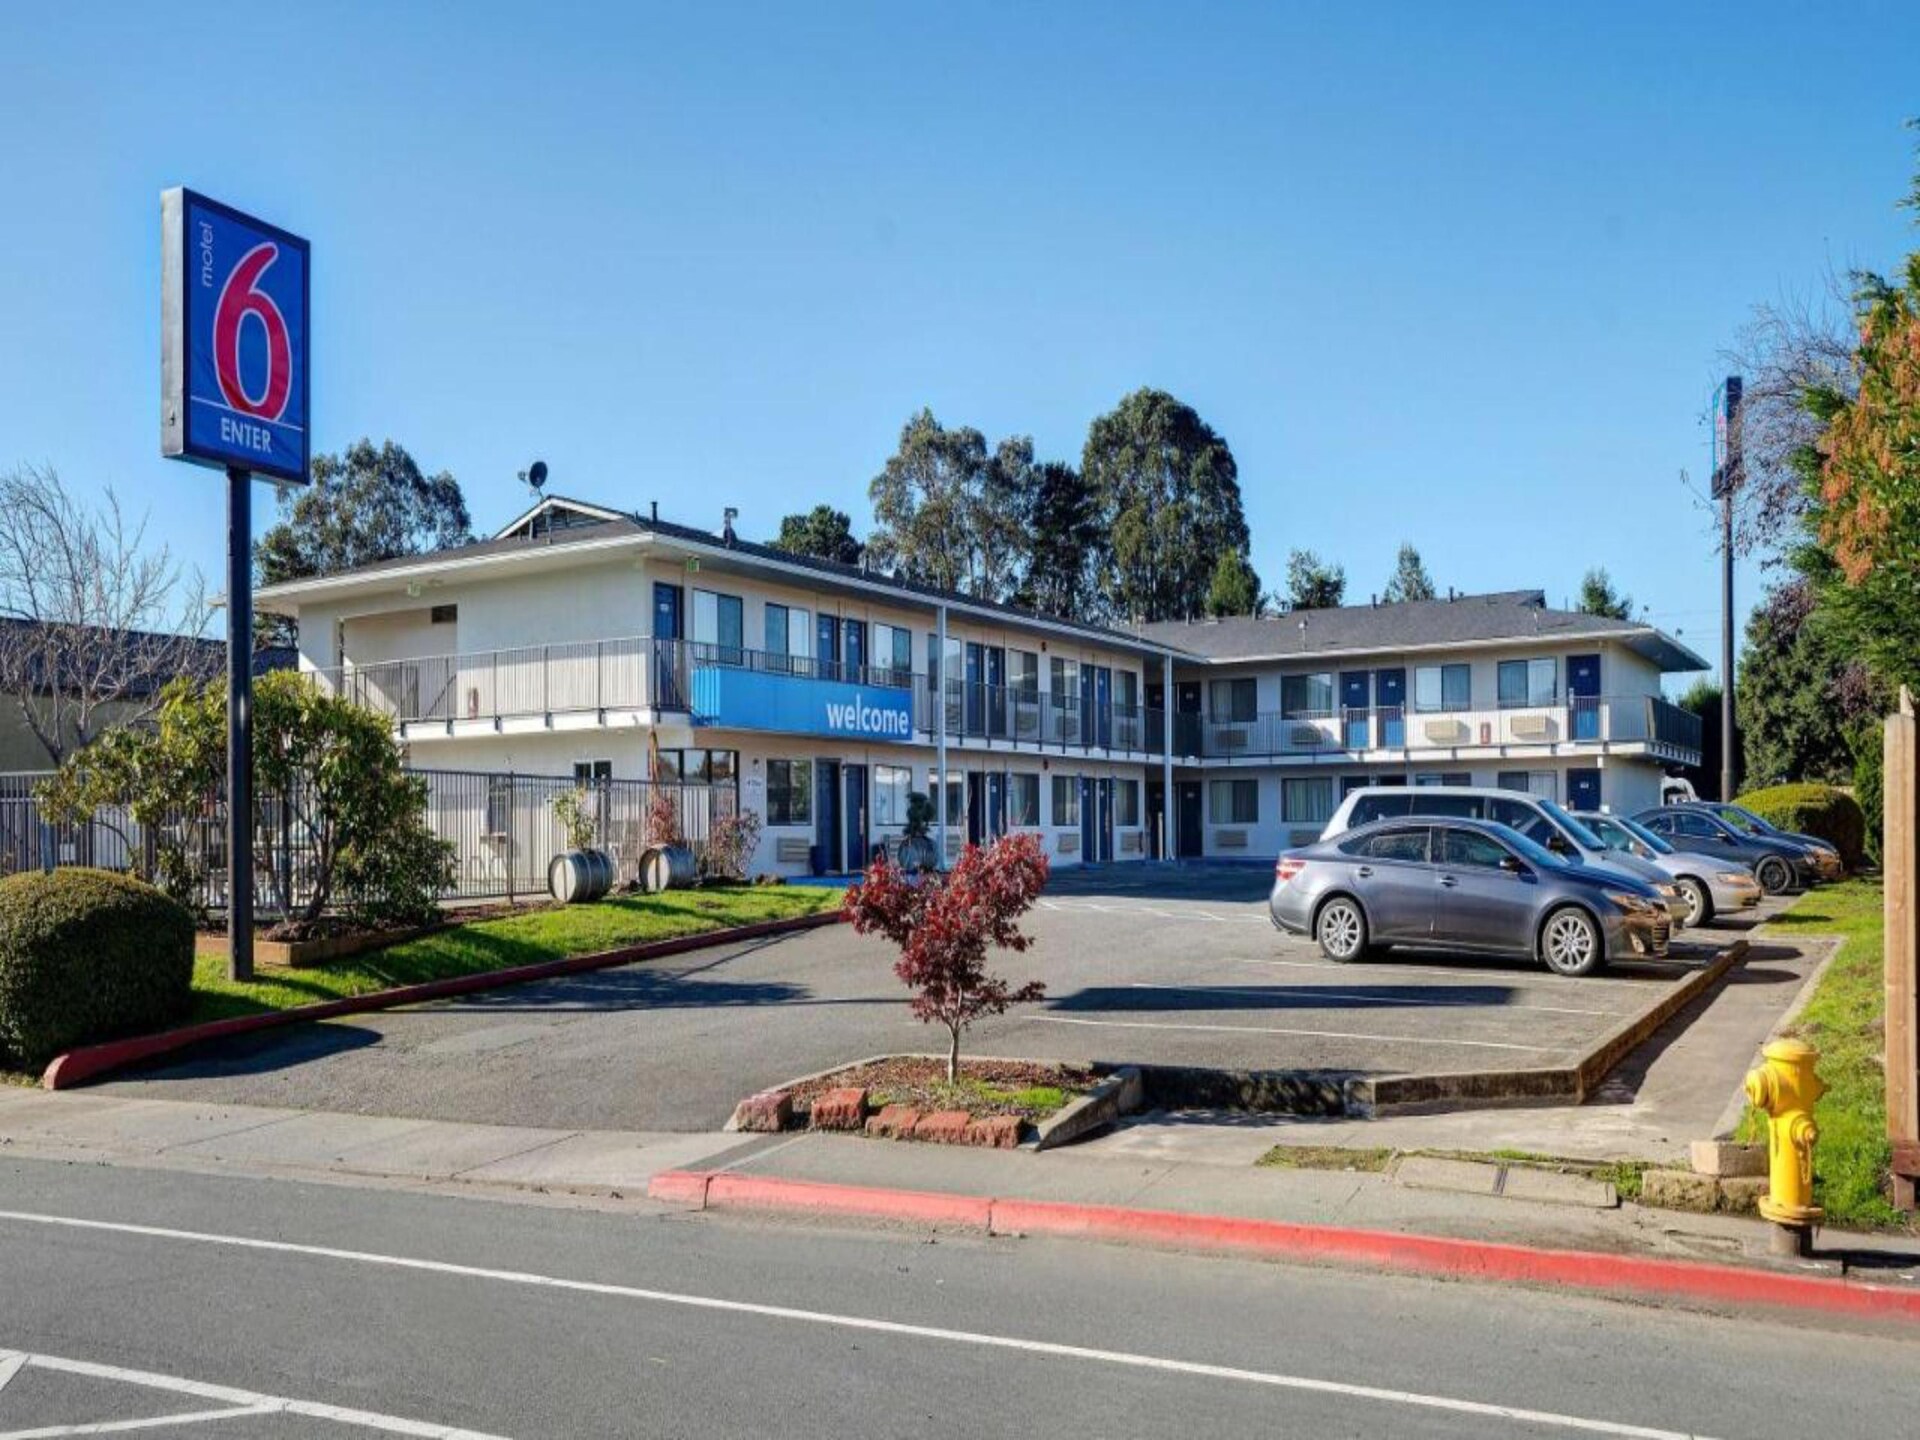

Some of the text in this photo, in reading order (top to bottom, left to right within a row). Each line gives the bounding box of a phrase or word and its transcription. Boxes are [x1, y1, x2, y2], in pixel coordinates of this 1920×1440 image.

[200, 221, 213, 288] motel
[213, 242, 292, 422] 6
[221, 417, 272, 454] ENTER
[826, 693, 909, 735] welcome
